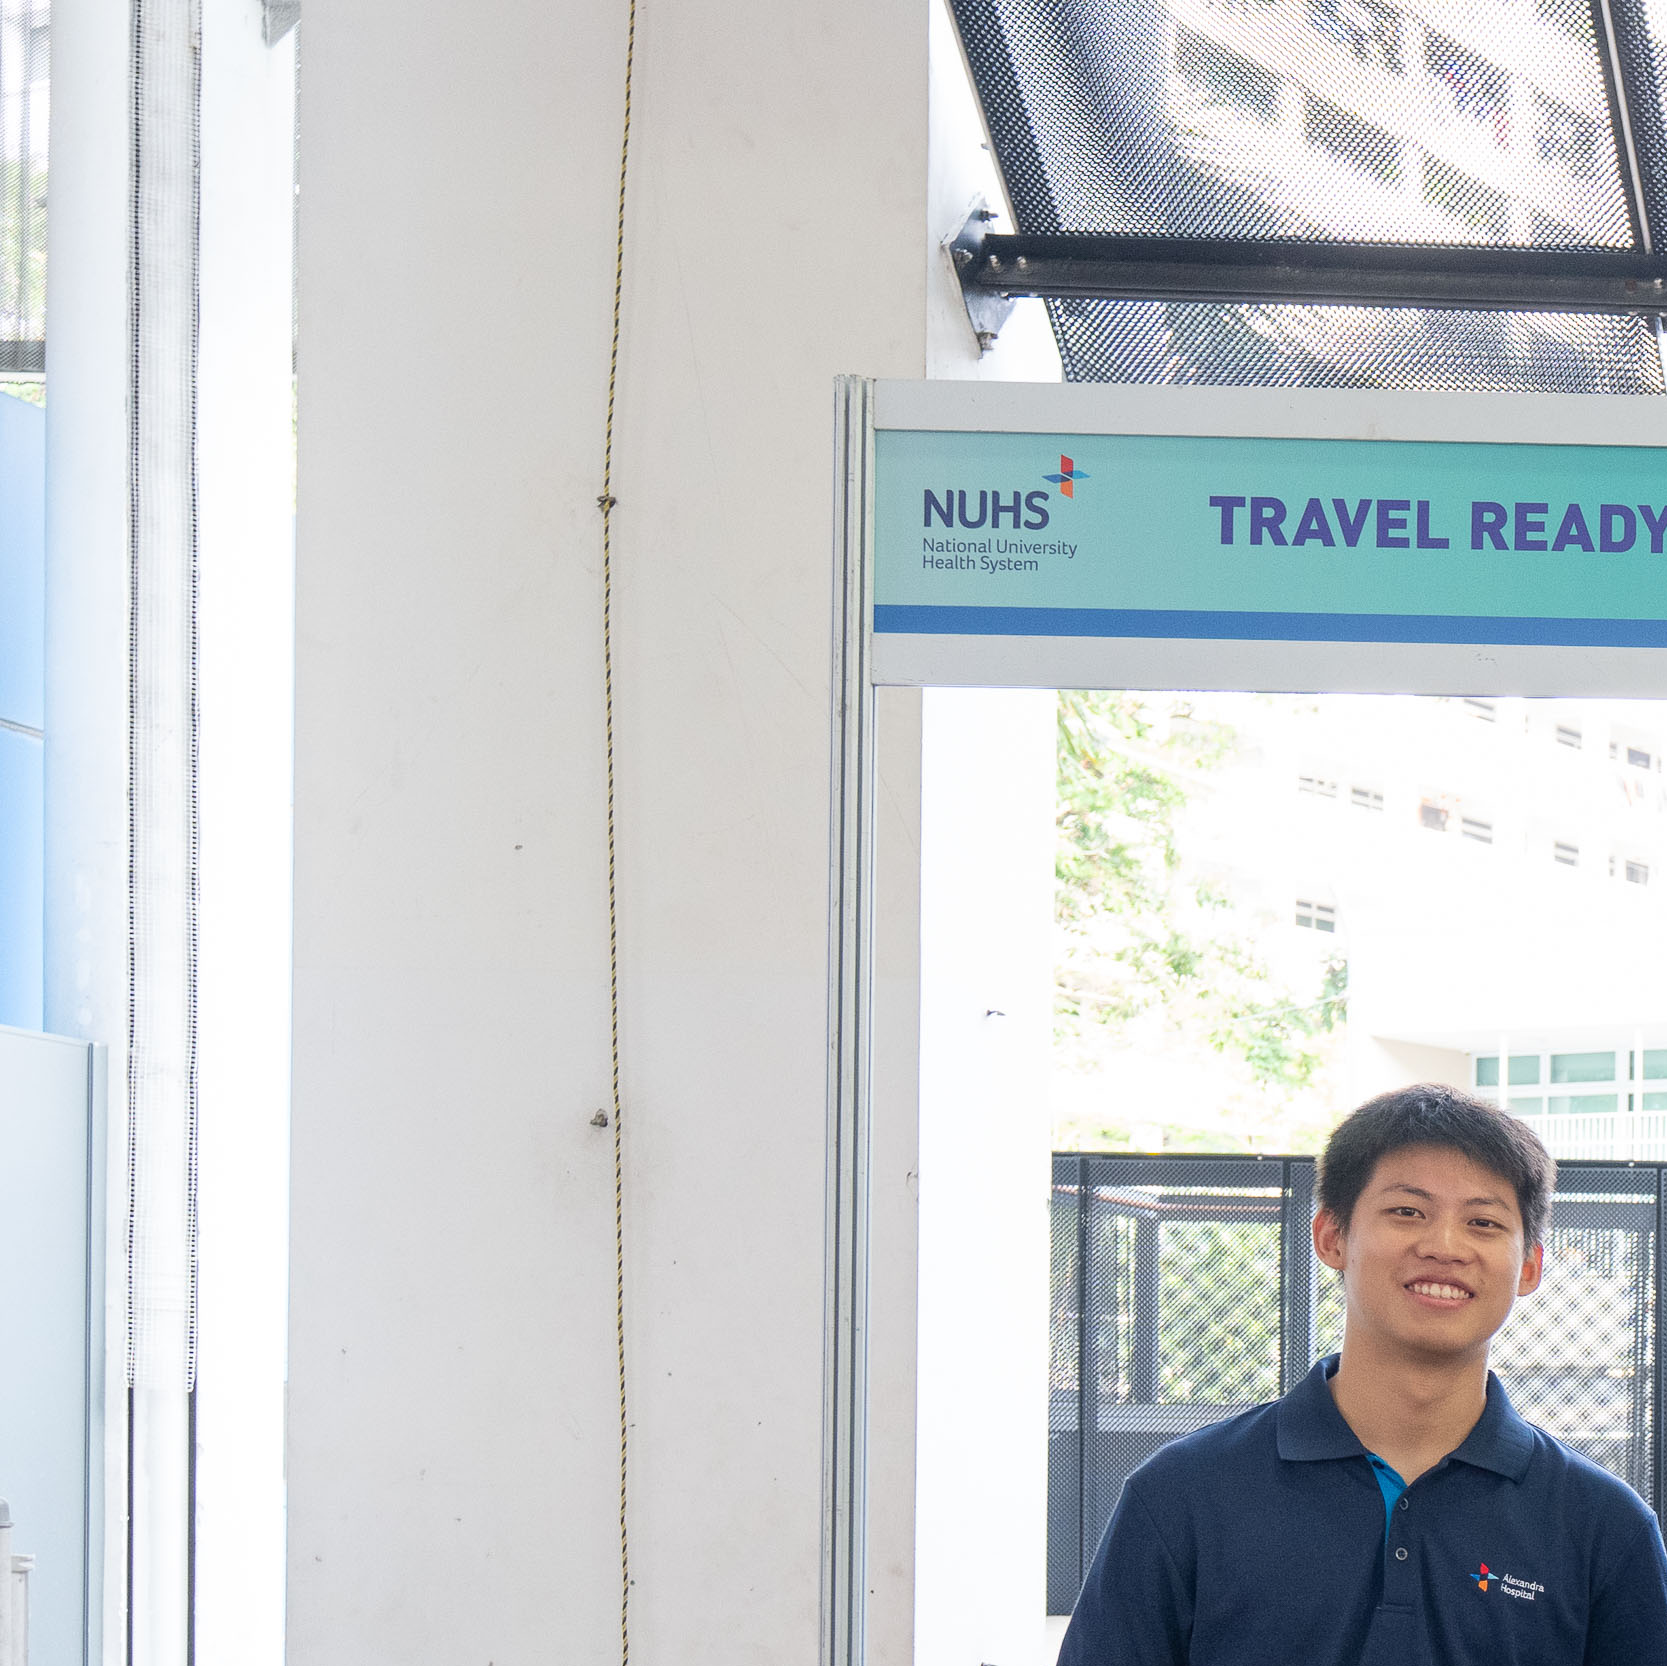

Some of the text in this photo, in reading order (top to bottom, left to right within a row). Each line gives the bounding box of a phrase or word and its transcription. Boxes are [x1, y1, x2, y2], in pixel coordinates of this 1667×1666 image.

[923, 488, 1050, 530] NUHS
[1209, 494, 1449, 550] TRAVEL
[922, 537, 1078, 559] National University
[922, 554, 1039, 575] Health System
[1500, 1583, 1535, 1601] Hospital
[1502, 1573, 1545, 1593] Alexandra
